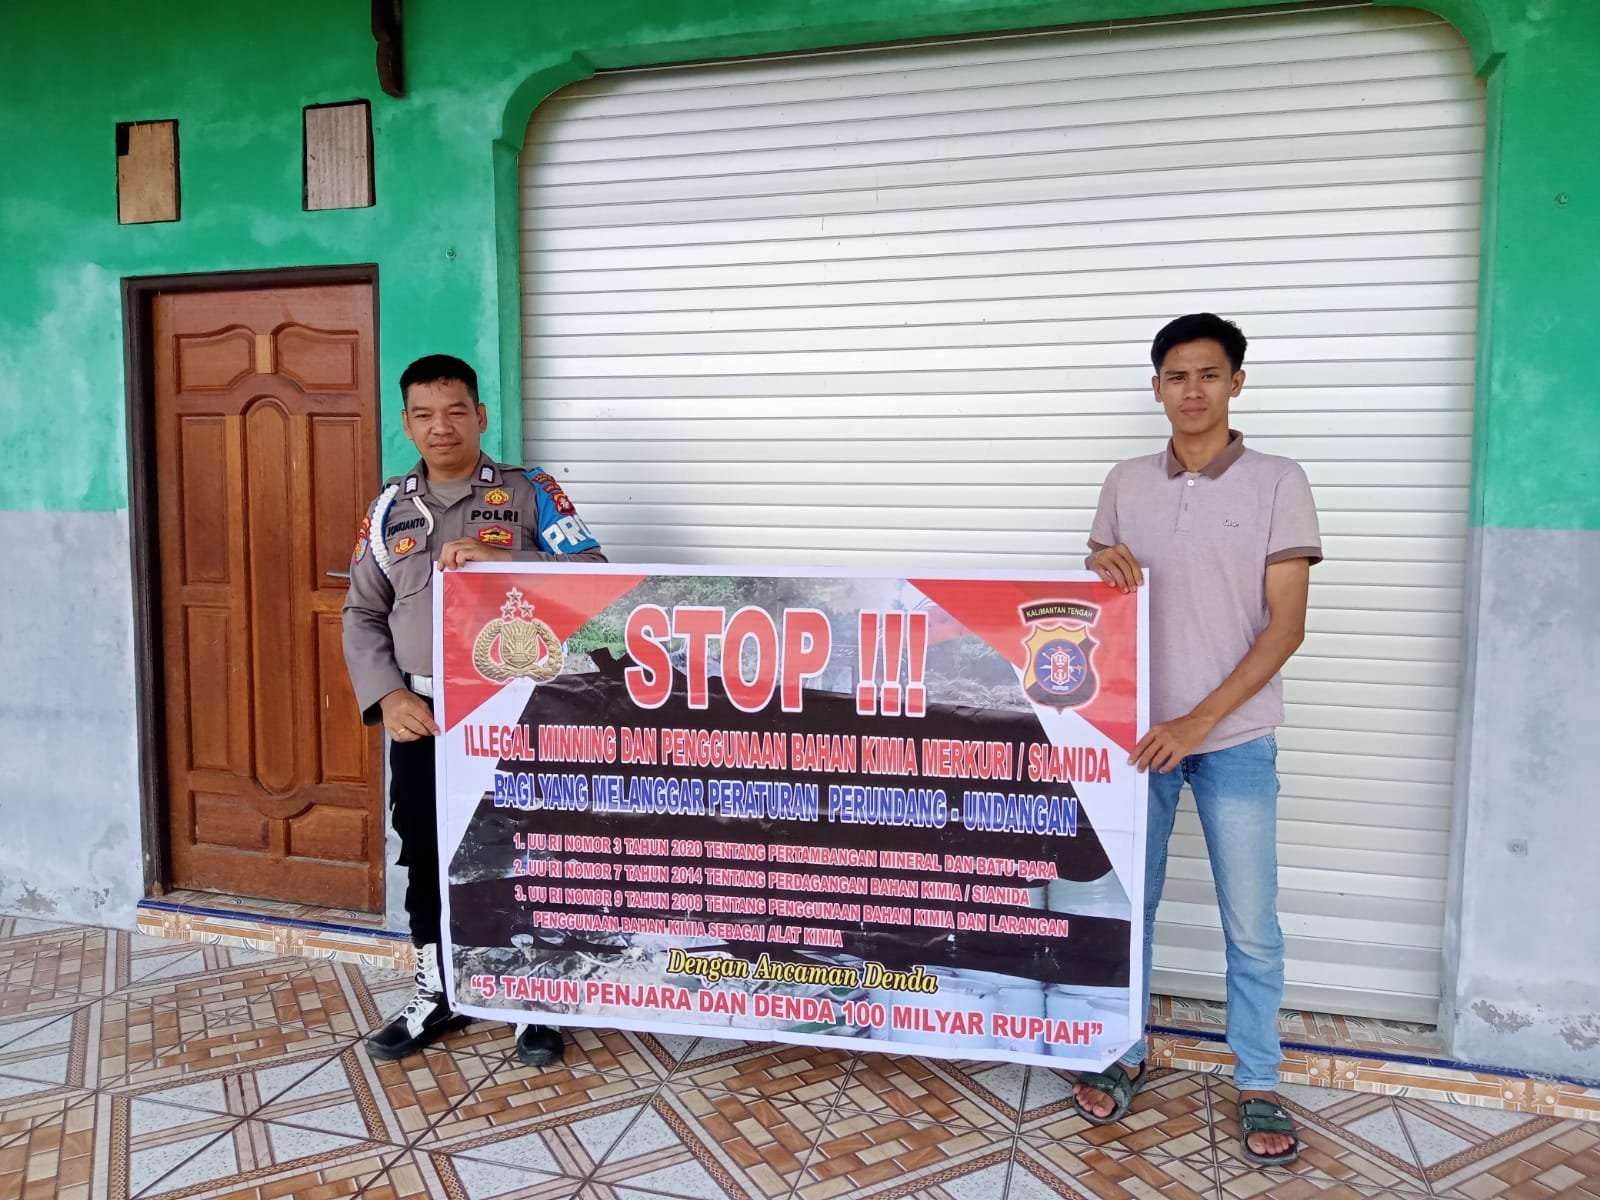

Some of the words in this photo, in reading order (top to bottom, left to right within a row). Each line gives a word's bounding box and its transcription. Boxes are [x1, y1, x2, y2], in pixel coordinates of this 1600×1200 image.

[471, 509, 518, 522] POLRI
[1026, 606, 1065, 617] KALIMANTAN
[1067, 607, 1093, 618] TENGAH
[624, 603, 832, 713] STOP
[464, 724, 534, 761] ILLEGAL
[539, 725, 616, 764] MINNING
[621, 727, 657, 765] DAN
[662, 728, 786, 769] PENGGUNAAN
[791, 733, 856, 772] BAHAN
[862, 736, 916, 776] KIMIA
[922, 738, 1013, 781] MERKURI
[1016, 742, 1024, 782] /
[1028, 743, 1112, 784] SIANIDA
[494, 772, 534, 809] BAGI
[539, 774, 587, 812] YANG
[592, 775, 704, 816] MELANGGAR
[708, 779, 818, 822] PERATURAN
[829, 785, 947, 829] PERUNDANG
[963, 791, 1077, 837] UNDANGAN
[513, 833, 525, 849] 1.
[528, 834, 547, 850] UU
[549, 834, 562, 851] RI
[565, 835, 611, 854] NOMOR
[613, 839, 622, 855] 3
[624, 839, 669, 857] TAHUN
[671, 840, 702, 858] 2020
[704, 841, 765, 861] TENTANG
[768, 844, 877, 867] PERTAMBANGAN
[880, 851, 942, 872] MINERAL
[945, 854, 973, 874] DAN
[976, 857, 1015, 877] BATU
[1018, 860, 1058, 880] BARA
[513, 859, 525, 875] 2.
[528, 860, 547, 877] UU
[549, 861, 562, 877] RI
[565, 861, 611, 880] NOMOR
[613, 866, 622, 881] 7
[624, 866, 669, 883] TAHUN
[671, 867, 702, 884] 2014
[704, 868, 765, 888] TENTANG
[768, 872, 868, 895] PERDAGANGAN
[870, 877, 919, 898] BAHAN
[921, 881, 962, 902] KIMIA
[964, 884, 971, 902] /
[972, 884, 1031, 906] SIANIDA
[514, 886, 526, 901] 3.
[528, 887, 547, 904] UU
[549, 887, 563, 903] RI
[565, 888, 612, 907] NOMOR
[613, 892, 623, 908] 9
[624, 892, 669, 910] TAHUN
[671, 893, 703, 911] 2008
[705, 895, 766, 915] TENTANG
[769, 899, 860, 921] PENGGUNAAN
[863, 904, 911, 925] BAHAN
[914, 908, 955, 929] KIMIA
[957, 913, 986, 932] DAN
[989, 915, 1068, 937] LARANGAN
[533, 911, 619, 932] PENGGUNAAN
[621, 917, 665, 936] BAHAN
[668, 919, 706, 938] KIMIA
[708, 921, 765, 942] SEBAGAI
[767, 925, 802, 944] ALAT
[803, 927, 843, 947] KIMIA
[667, 948, 749, 982] Dengan
[753, 953, 858, 987] Ancaman
[862, 960, 938, 993] Denda
[501, 975, 579, 1004] TAHUN
[586, 981, 691, 1011] PENJARA
[698, 987, 747, 1016] DAN
[754, 994, 836, 1024] DENDA
[842, 1002, 886, 1027] 100
[892, 1004, 985, 1036] MILYAR
